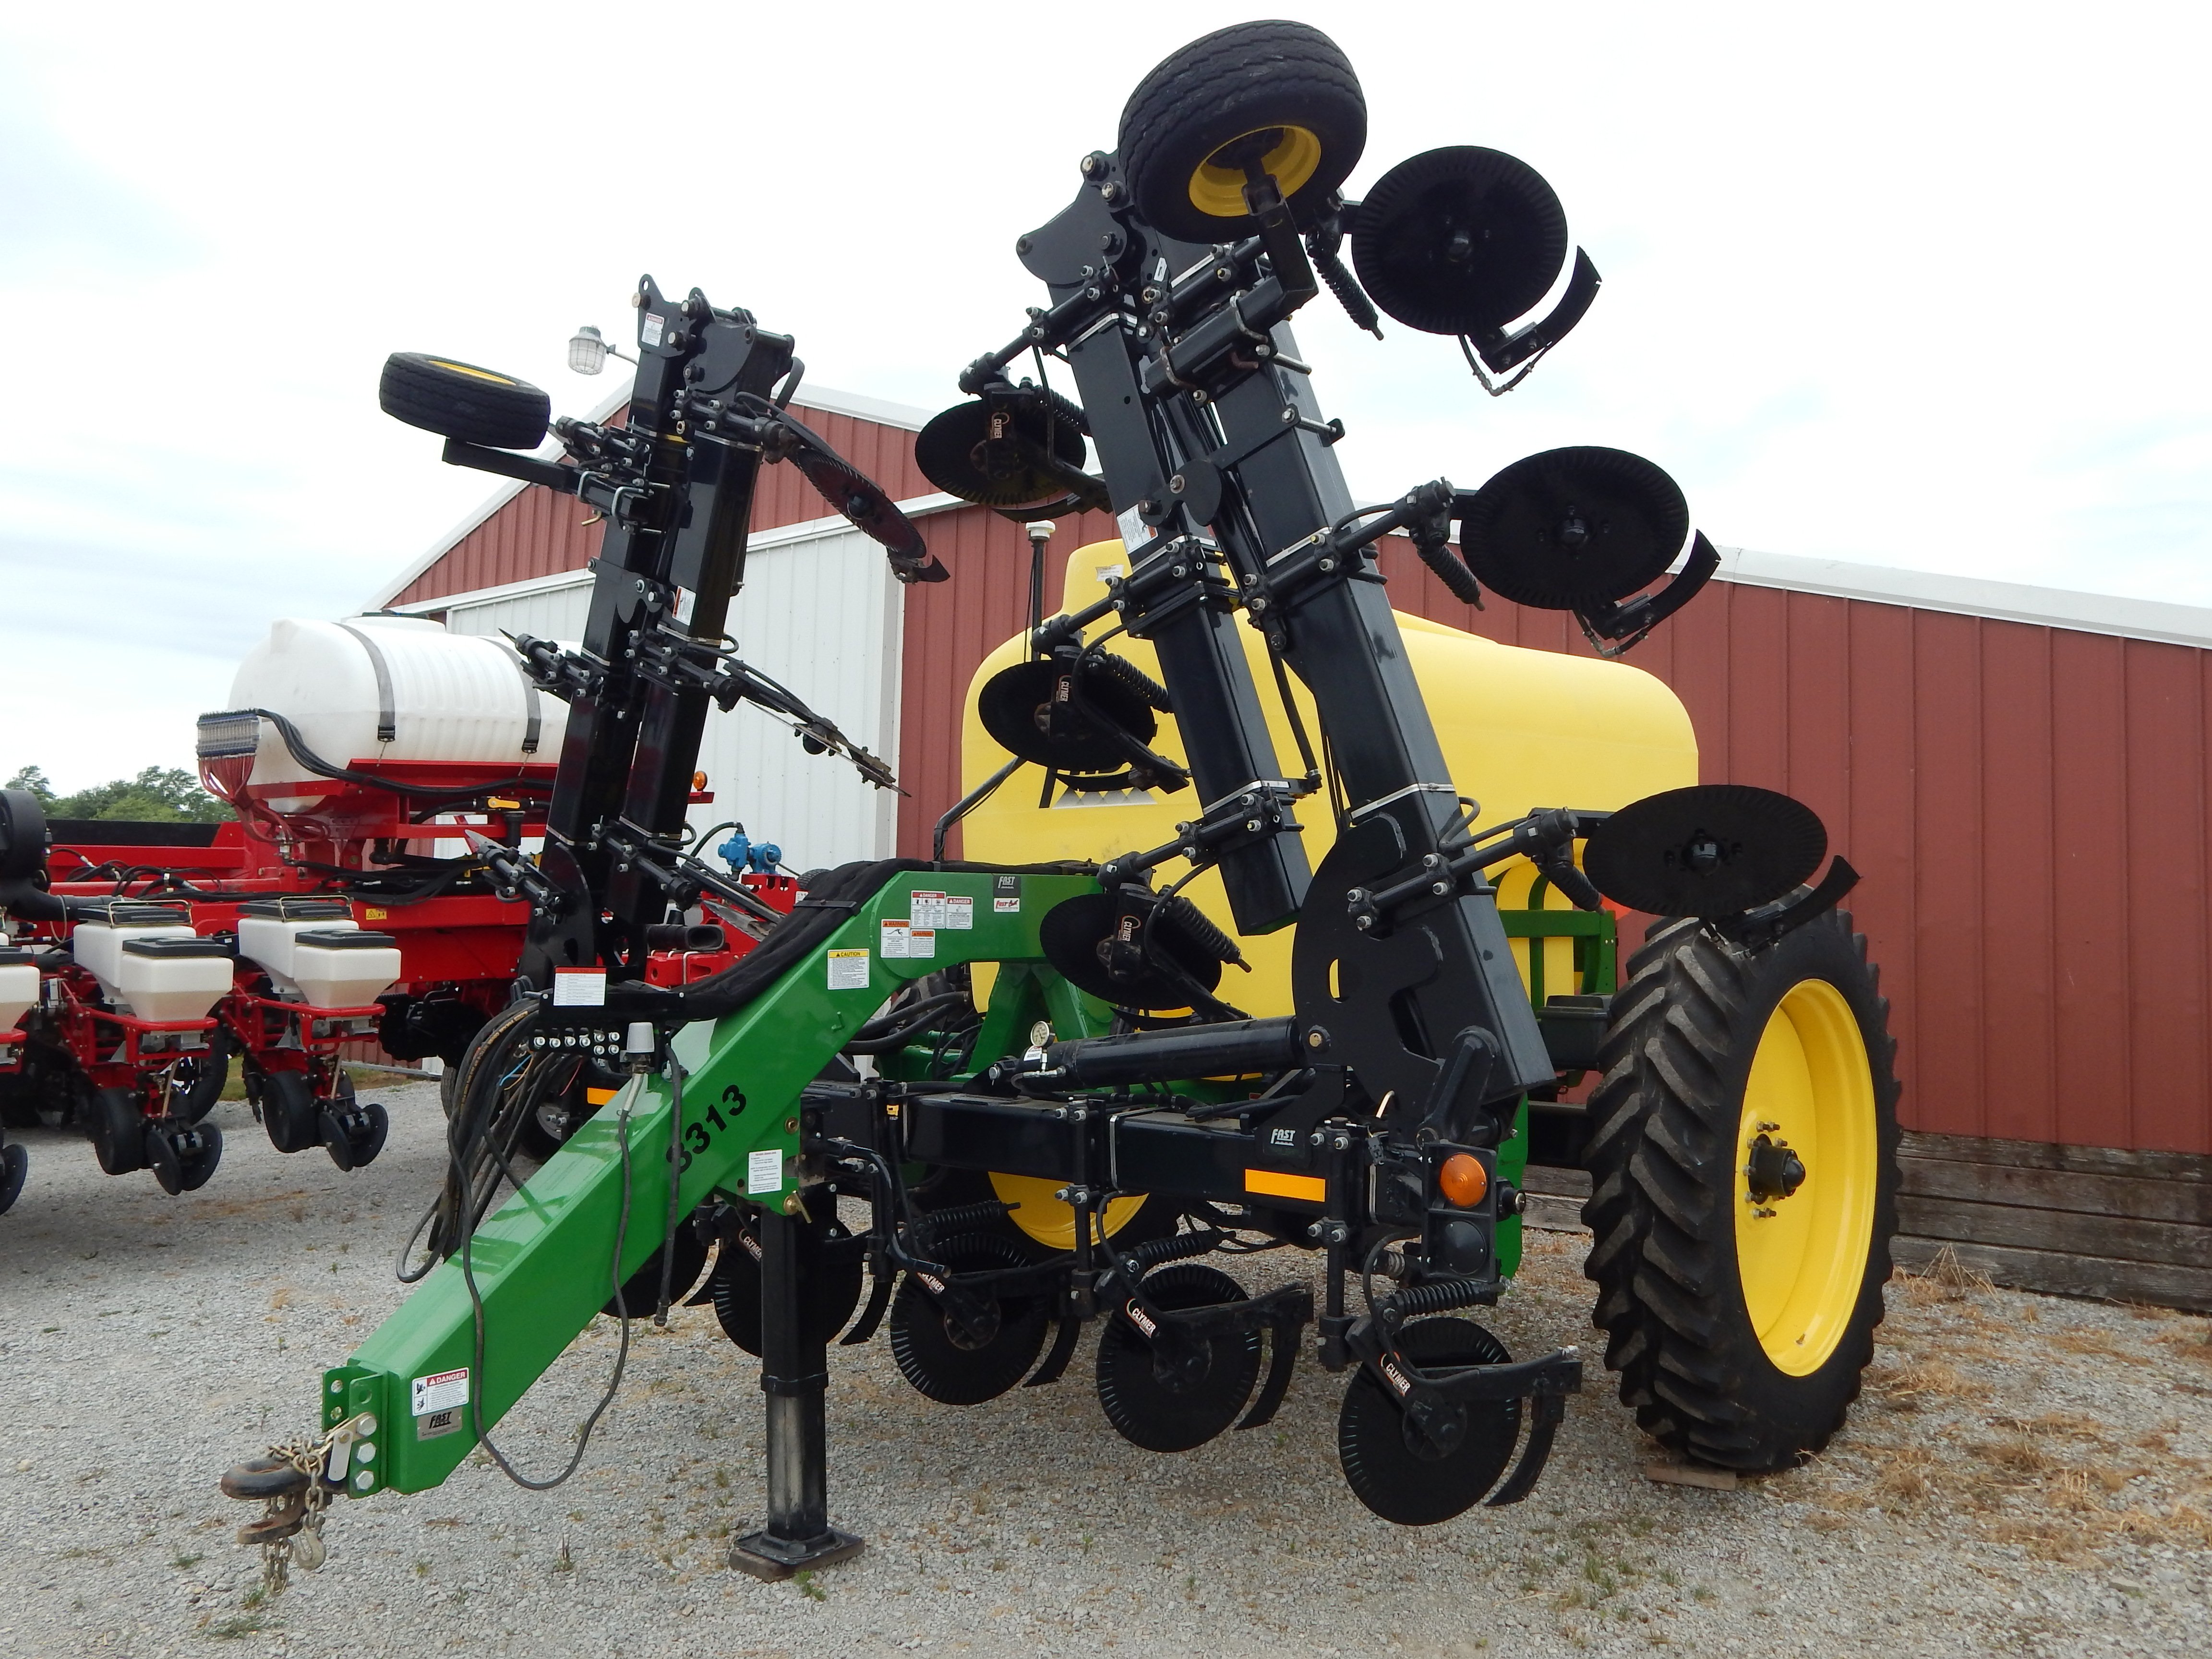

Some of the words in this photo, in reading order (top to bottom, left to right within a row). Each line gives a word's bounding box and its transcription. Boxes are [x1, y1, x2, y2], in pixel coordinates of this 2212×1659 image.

[1059, 681, 1070, 702] CLYMER
[998, 876, 1016, 889] FAST
[1121, 921, 1132, 942] CLYMER
[1270, 1128, 1296, 1144] FAST
[1132, 1308, 1156, 1333] CLYMER
[436, 1371, 466, 1384] DANGER
[1386, 1362, 1411, 1393] CLYMER
[429, 1411, 452, 1429] FAST
